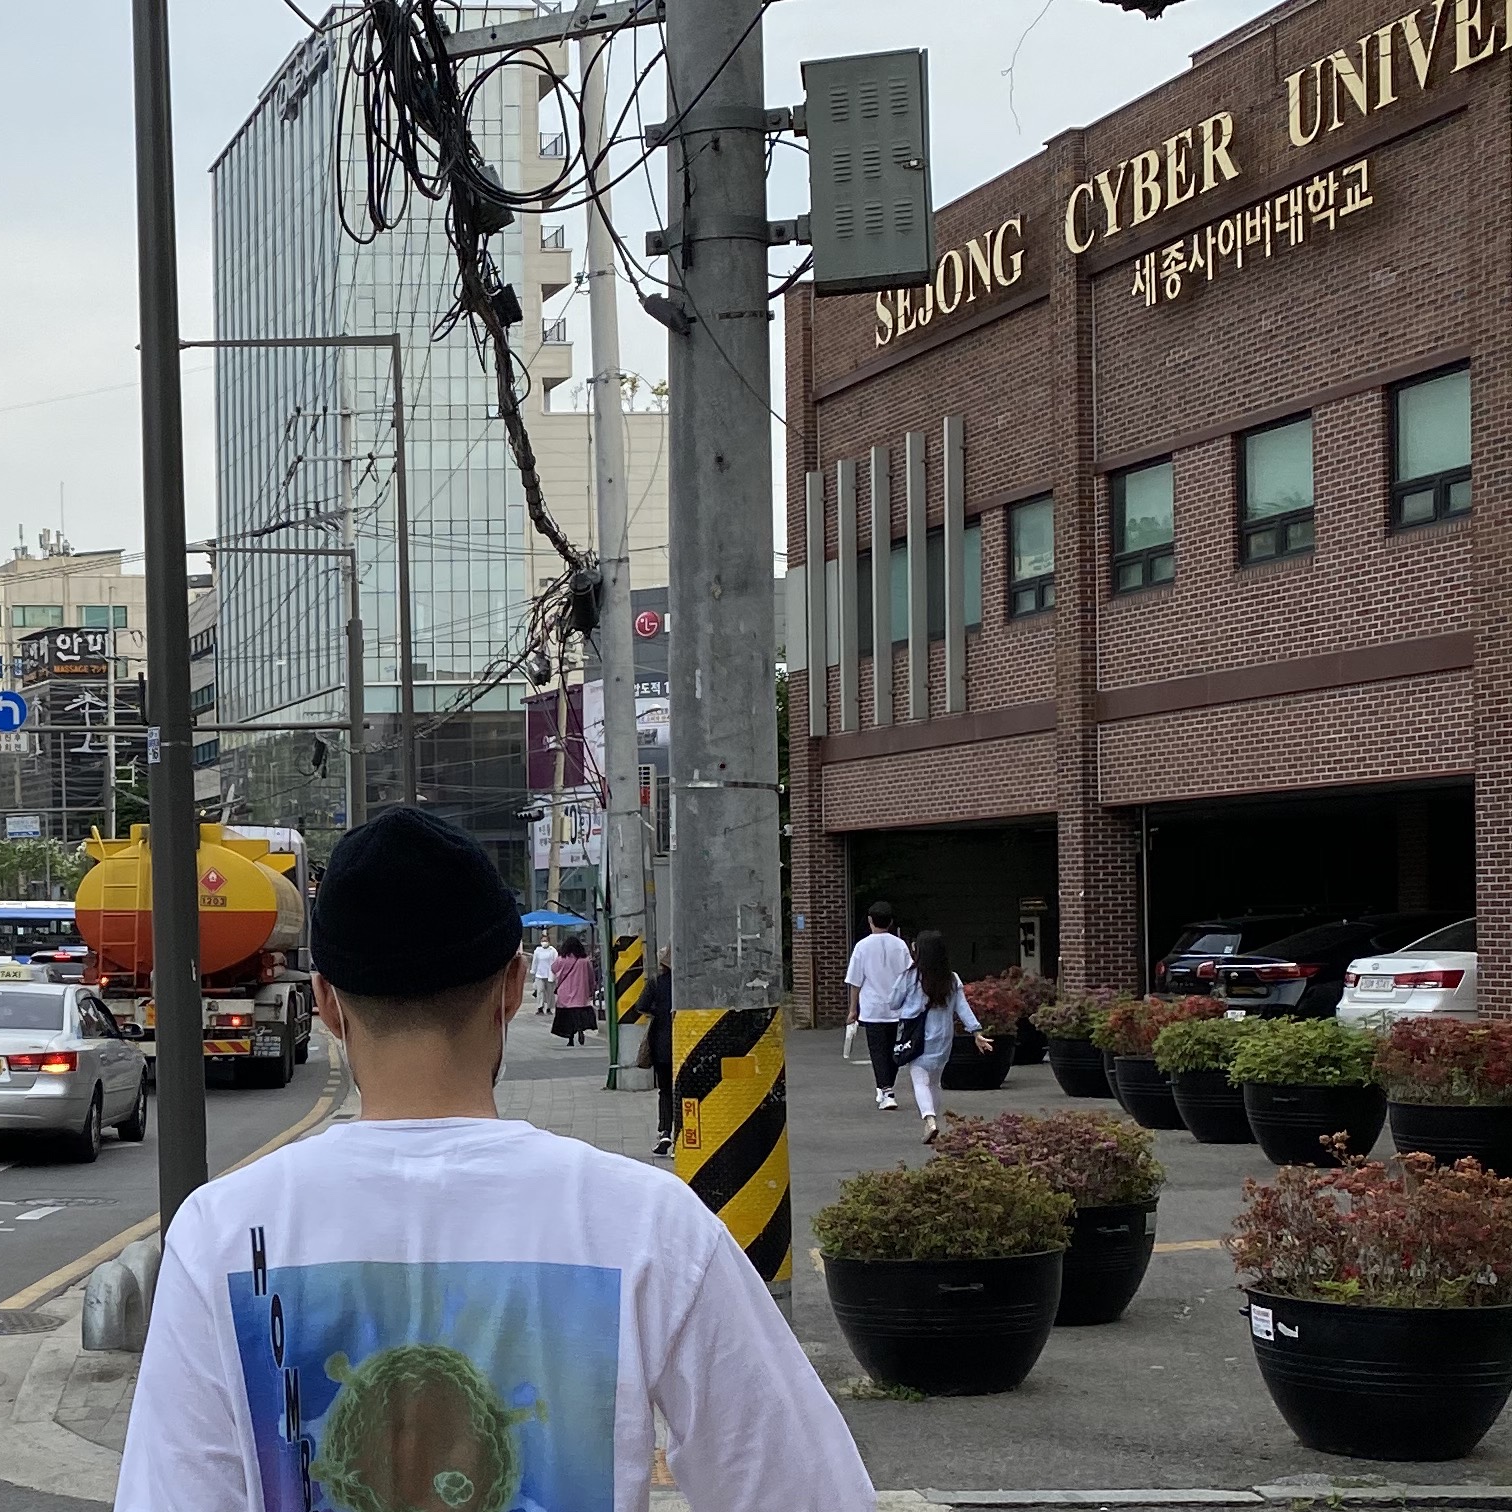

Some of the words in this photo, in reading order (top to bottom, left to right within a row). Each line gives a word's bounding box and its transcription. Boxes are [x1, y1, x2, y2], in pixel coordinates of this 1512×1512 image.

[874, 215, 1025, 347] SEJONG
[1064, 108, 1244, 256] CYBER
[1130, 158, 1375, 308] 세종사이버대학교
[684, 1101, 697, 1145] 위험
